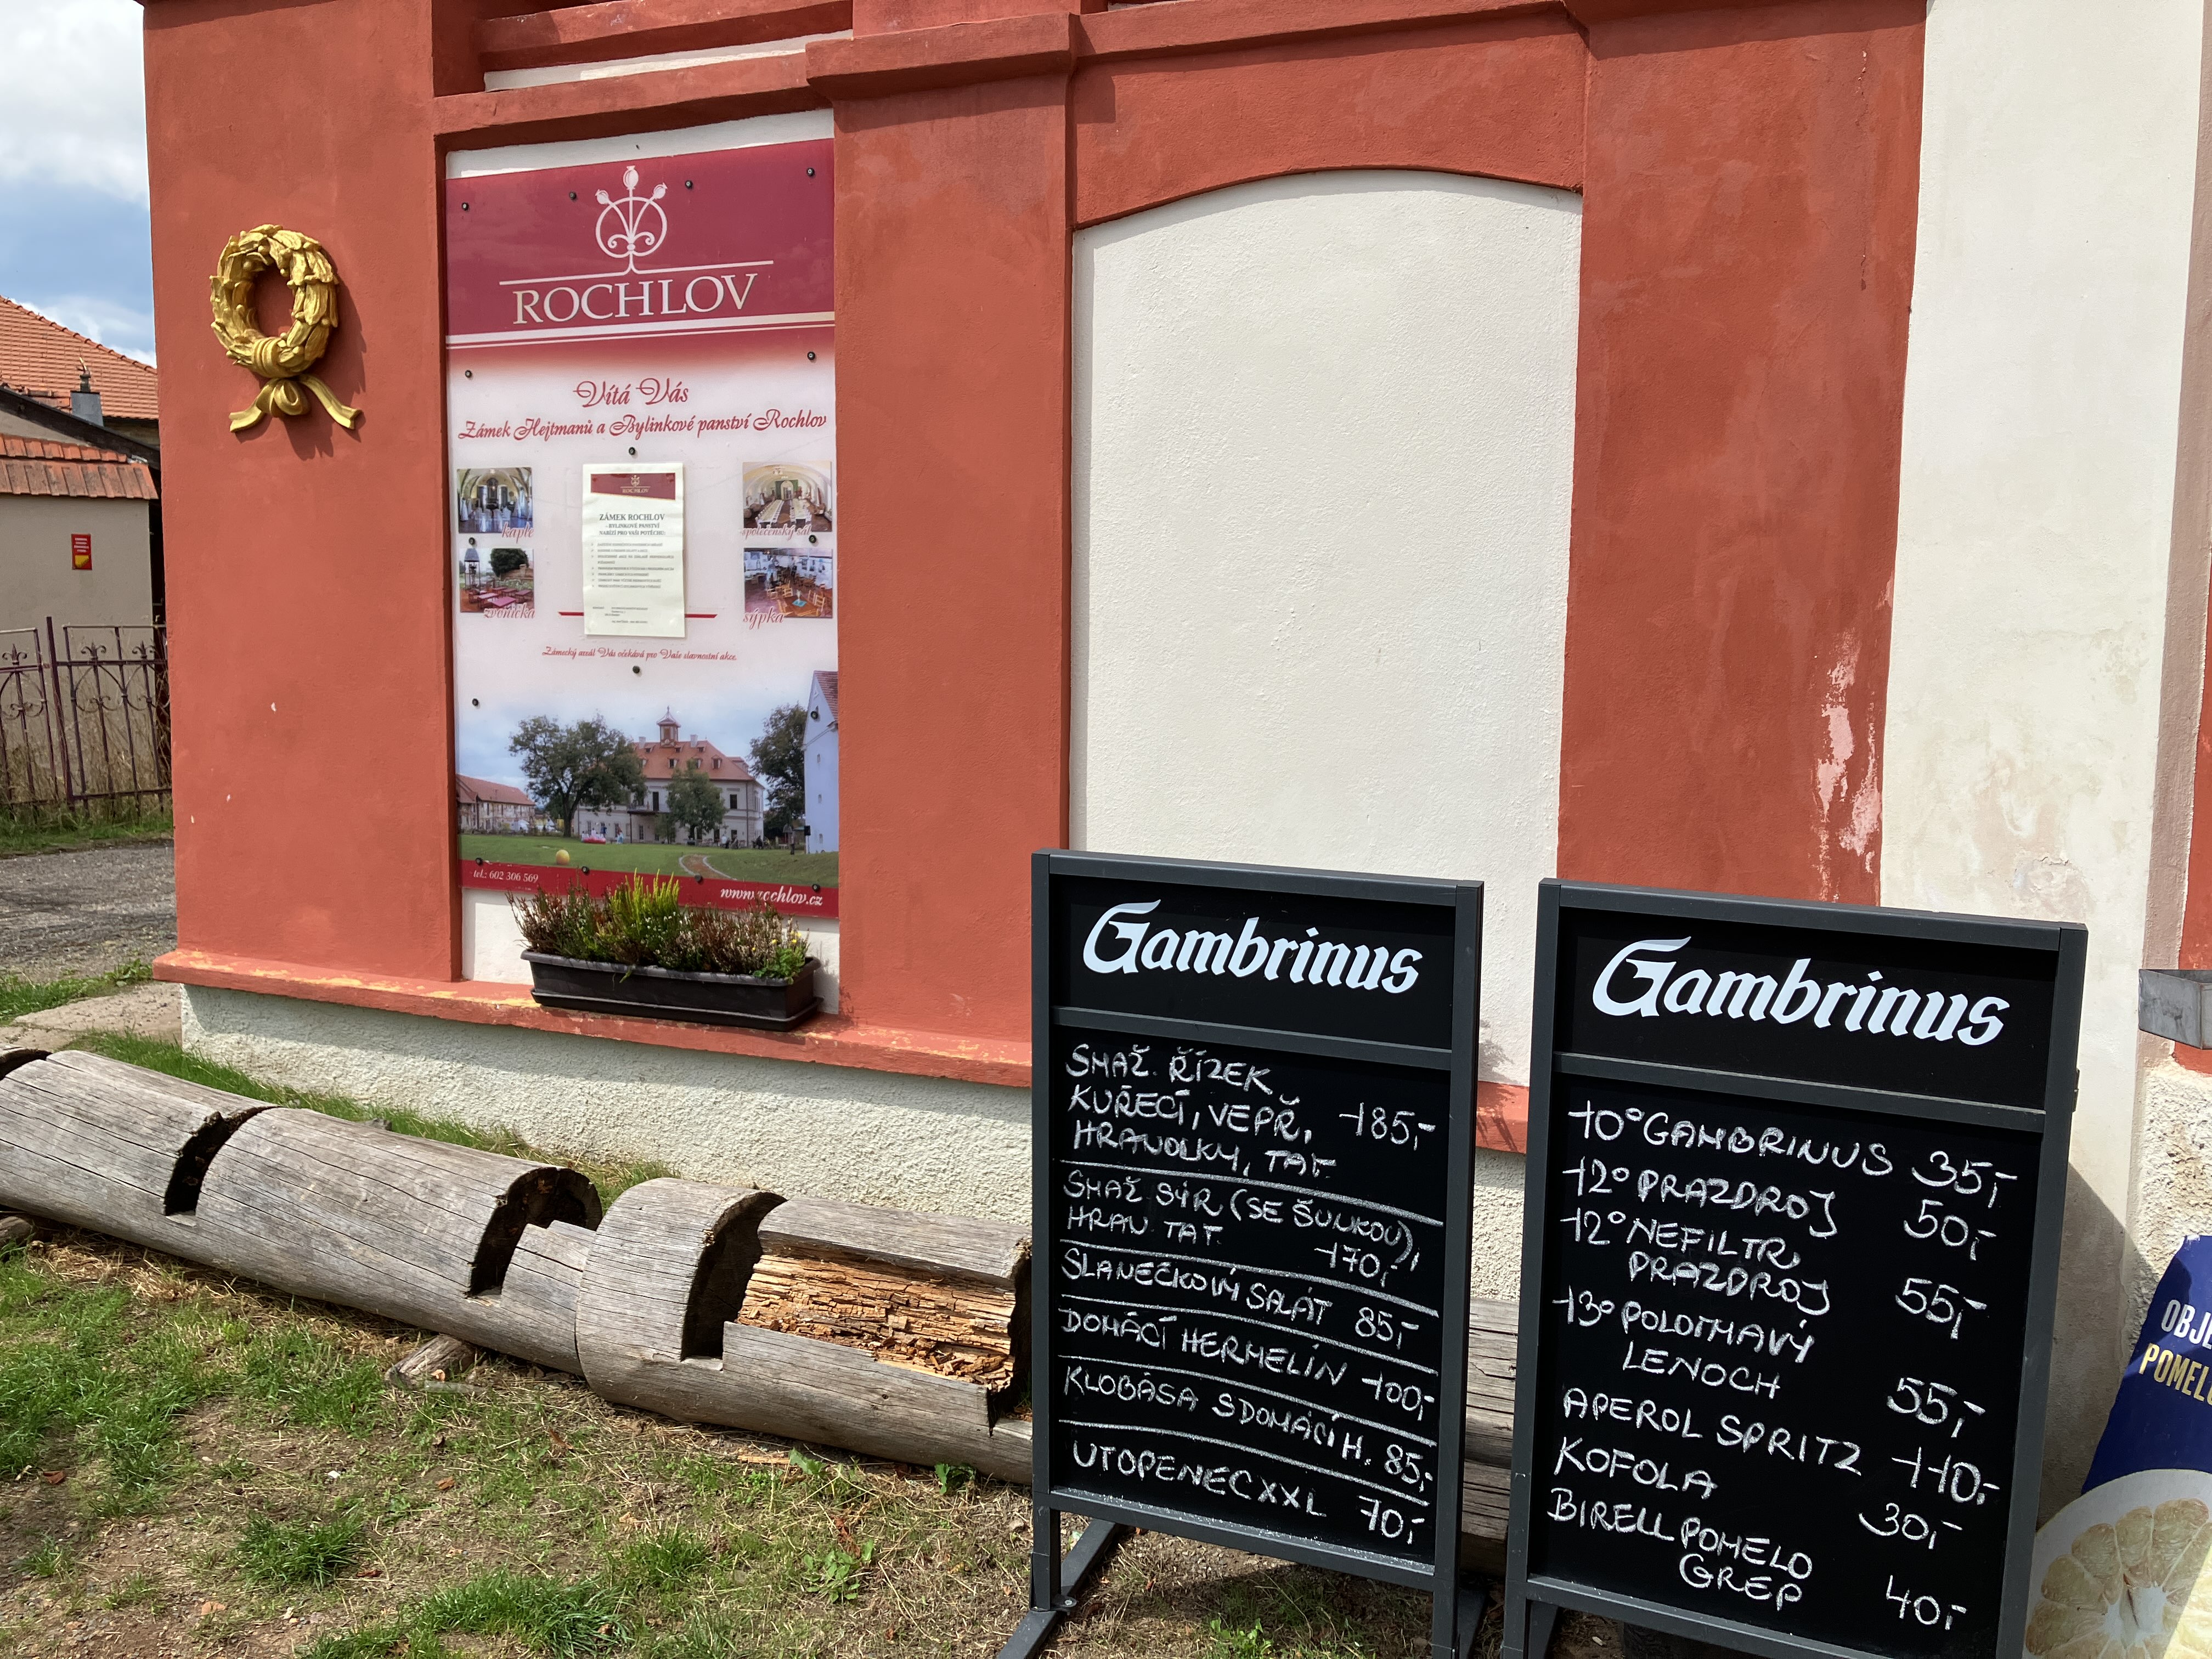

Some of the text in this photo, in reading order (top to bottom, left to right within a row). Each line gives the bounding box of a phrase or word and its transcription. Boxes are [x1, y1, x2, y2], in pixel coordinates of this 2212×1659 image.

[512, 273, 757, 325] ROCHLOV
[458, 409, 827, 442] Zámek Hejtmanů a Bylinkové panství Rochlov
[573, 377, 689, 408] Vítá Vás
[501, 522, 534, 543] kaple
[599, 512, 626, 521] ZÁMEK
[796, 524, 812, 536] sál
[542, 646, 576, 659] Zámecký
[578, 648, 596, 657] areál
[598, 647, 616, 657] Vás
[618, 649, 645, 658] očekává
[646, 652, 658, 661] pro
[660, 649, 682, 659] Vaše
[684, 651, 719, 660] slavnostní
[743, 606, 785, 630] sýpka
[489, 870, 504, 880] 602
[506, 871, 521, 882] 306
[522, 873, 539, 884] 569
[1083, 899, 1423, 994] Gambrinus
[1592, 936, 2010, 1046] Gambrinus
[1169, 1046, 1273, 1095] ŘÍZEK
[1644, 1112, 1893, 1176] GAMBRINUS
[1911, 1151, 2018, 1209] 35,-
[1156, 1180, 1223, 1217] SÝR
[1230, 1189, 1283, 1223] (SE
[1638, 1169, 1837, 1238] PRAZDROJ
[1903, 1199, 1997, 1261] 50,-
[1062, 1248, 1419, 1350] SLANEČKOVÝ SALÁT 85,-
[1621, 1300, 1815, 1363] POLOTMAVÝ
[1628, 1251, 1988, 1339] PRAZDROJ 55,-
[1058, 1308, 1177, 1351] DOMÁCÍ
[1181, 1327, 1347, 1386] HERMELÍN
[1622, 1340, 1986, 1438] LENOCH 55,-
[1064, 1365, 1199, 1412] KLOBÁSA
[1384, 1444, 1433, 1492] 85,-
[1563, 1388, 1702, 1438] APEROL
[1717, 1415, 1861, 1476] SPRITZ
[1073, 1440, 1425, 1545] UTOPENEC XXL 70,-
[1554, 1437, 1963, 1549] KOFOLA 30,-
[1547, 1487, 1813, 1579] BIRELL POMELO
[1679, 1554, 1967, 1630] GREP 40,-
